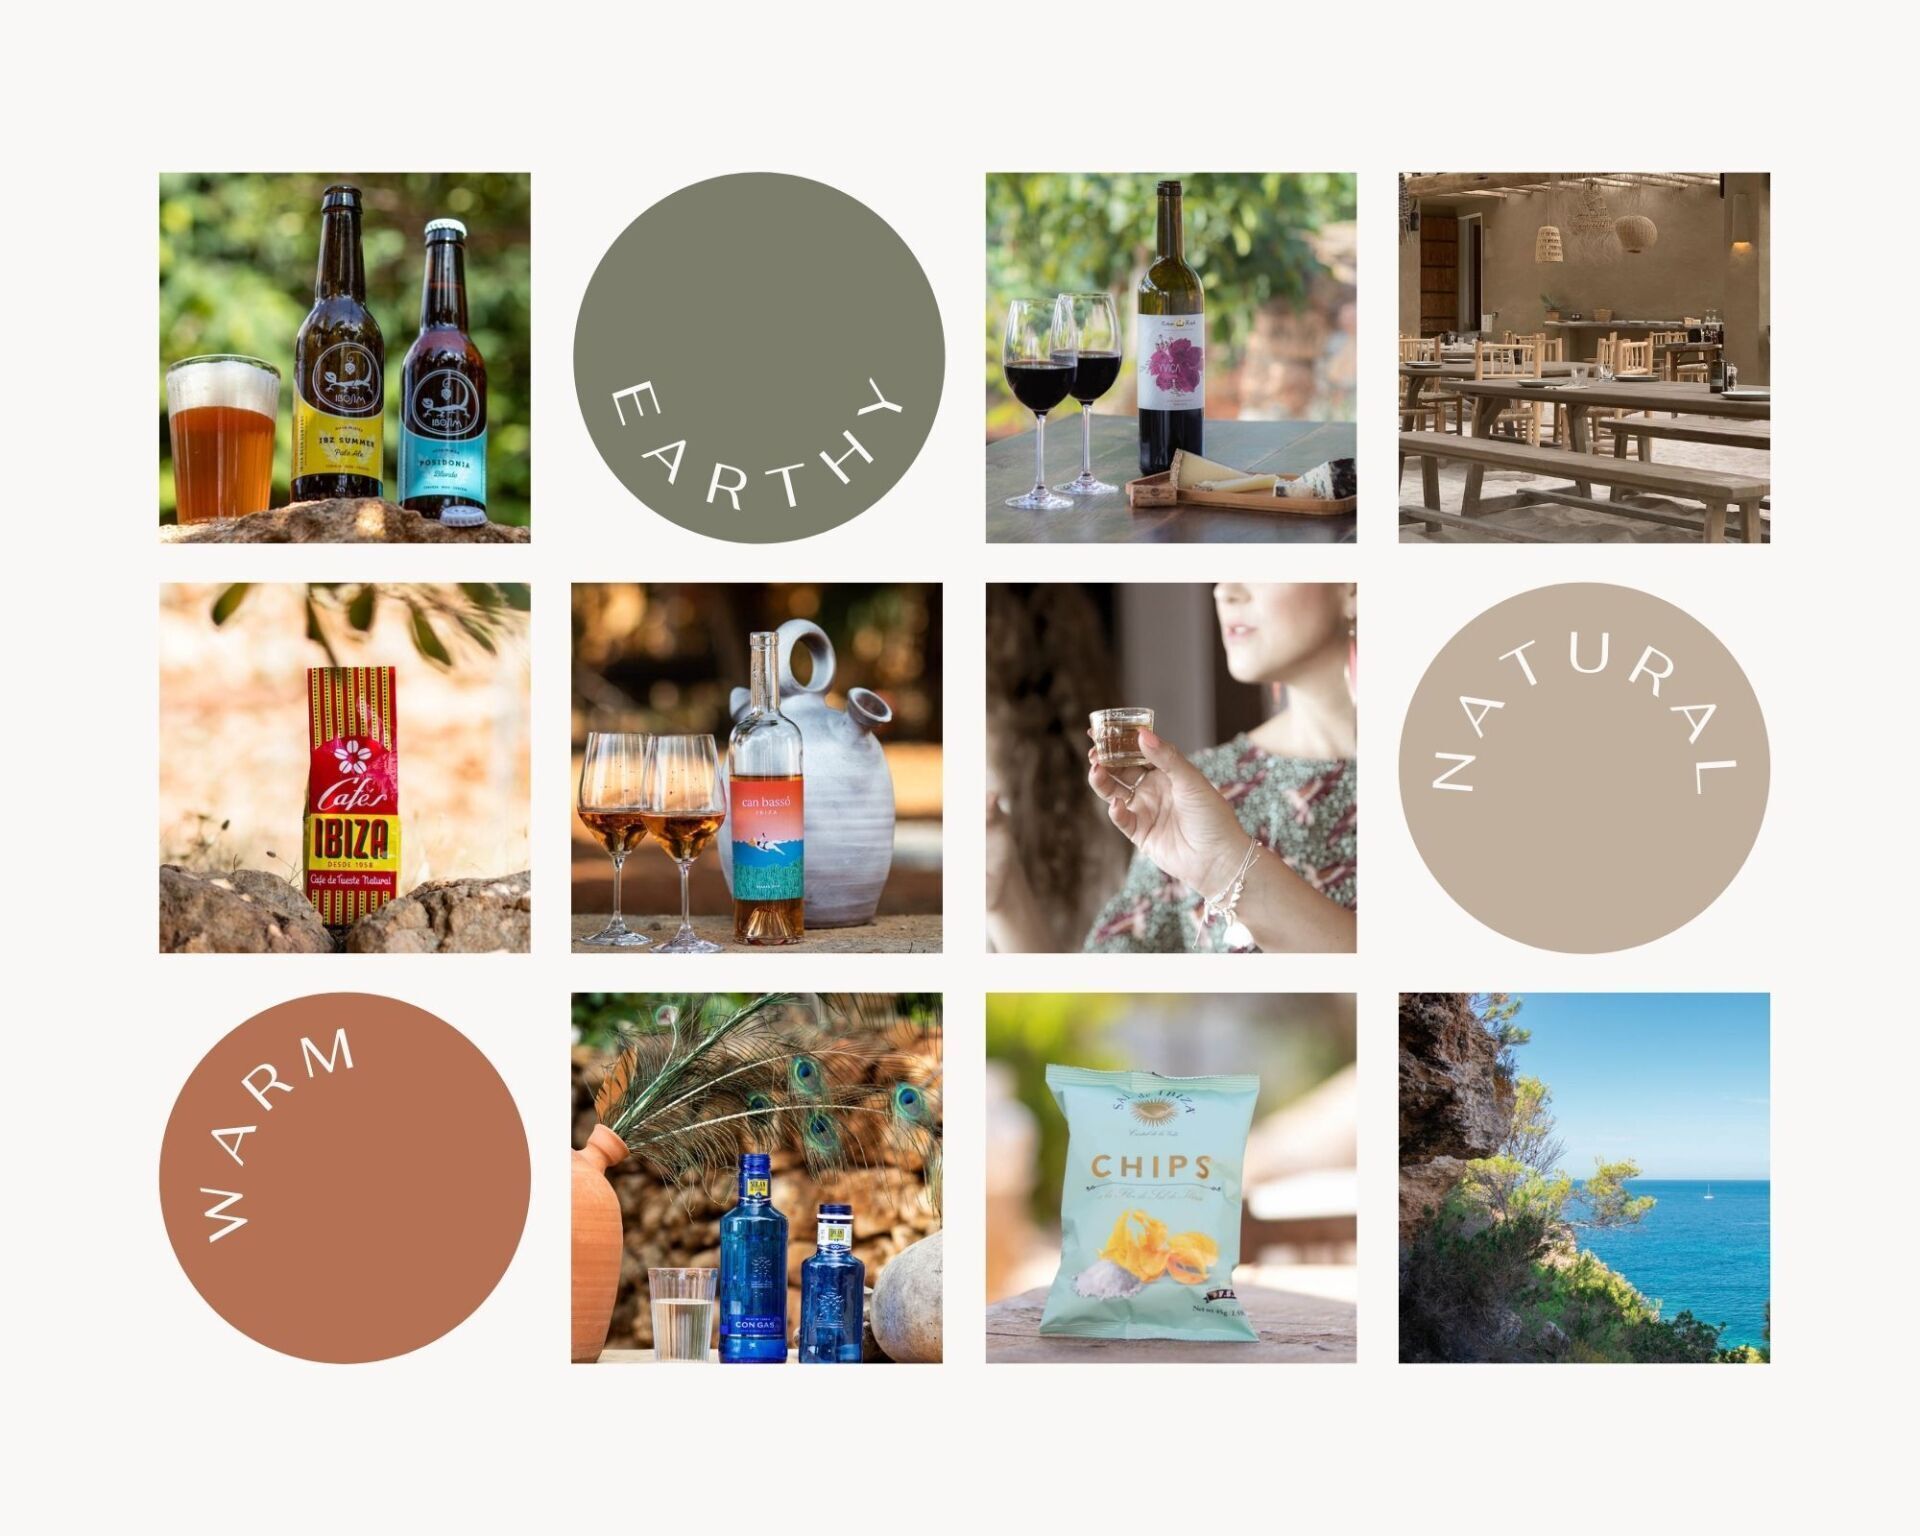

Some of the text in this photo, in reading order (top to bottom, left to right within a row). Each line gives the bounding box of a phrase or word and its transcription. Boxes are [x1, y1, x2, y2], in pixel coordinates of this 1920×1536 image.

[419, 458, 470, 469] POSIDONIA
[317, 776, 388, 811] Cafés
[742, 799, 759, 807] can
[314, 818, 389, 860] IBIZA
[327, 874, 337, 885] de
[362, 874, 392, 885] Natural
[1158, 1090, 1196, 1114] IBIZA
[1091, 1154, 1212, 1180] CHIPS
[735, 1321, 775, 1329] CON GAS
